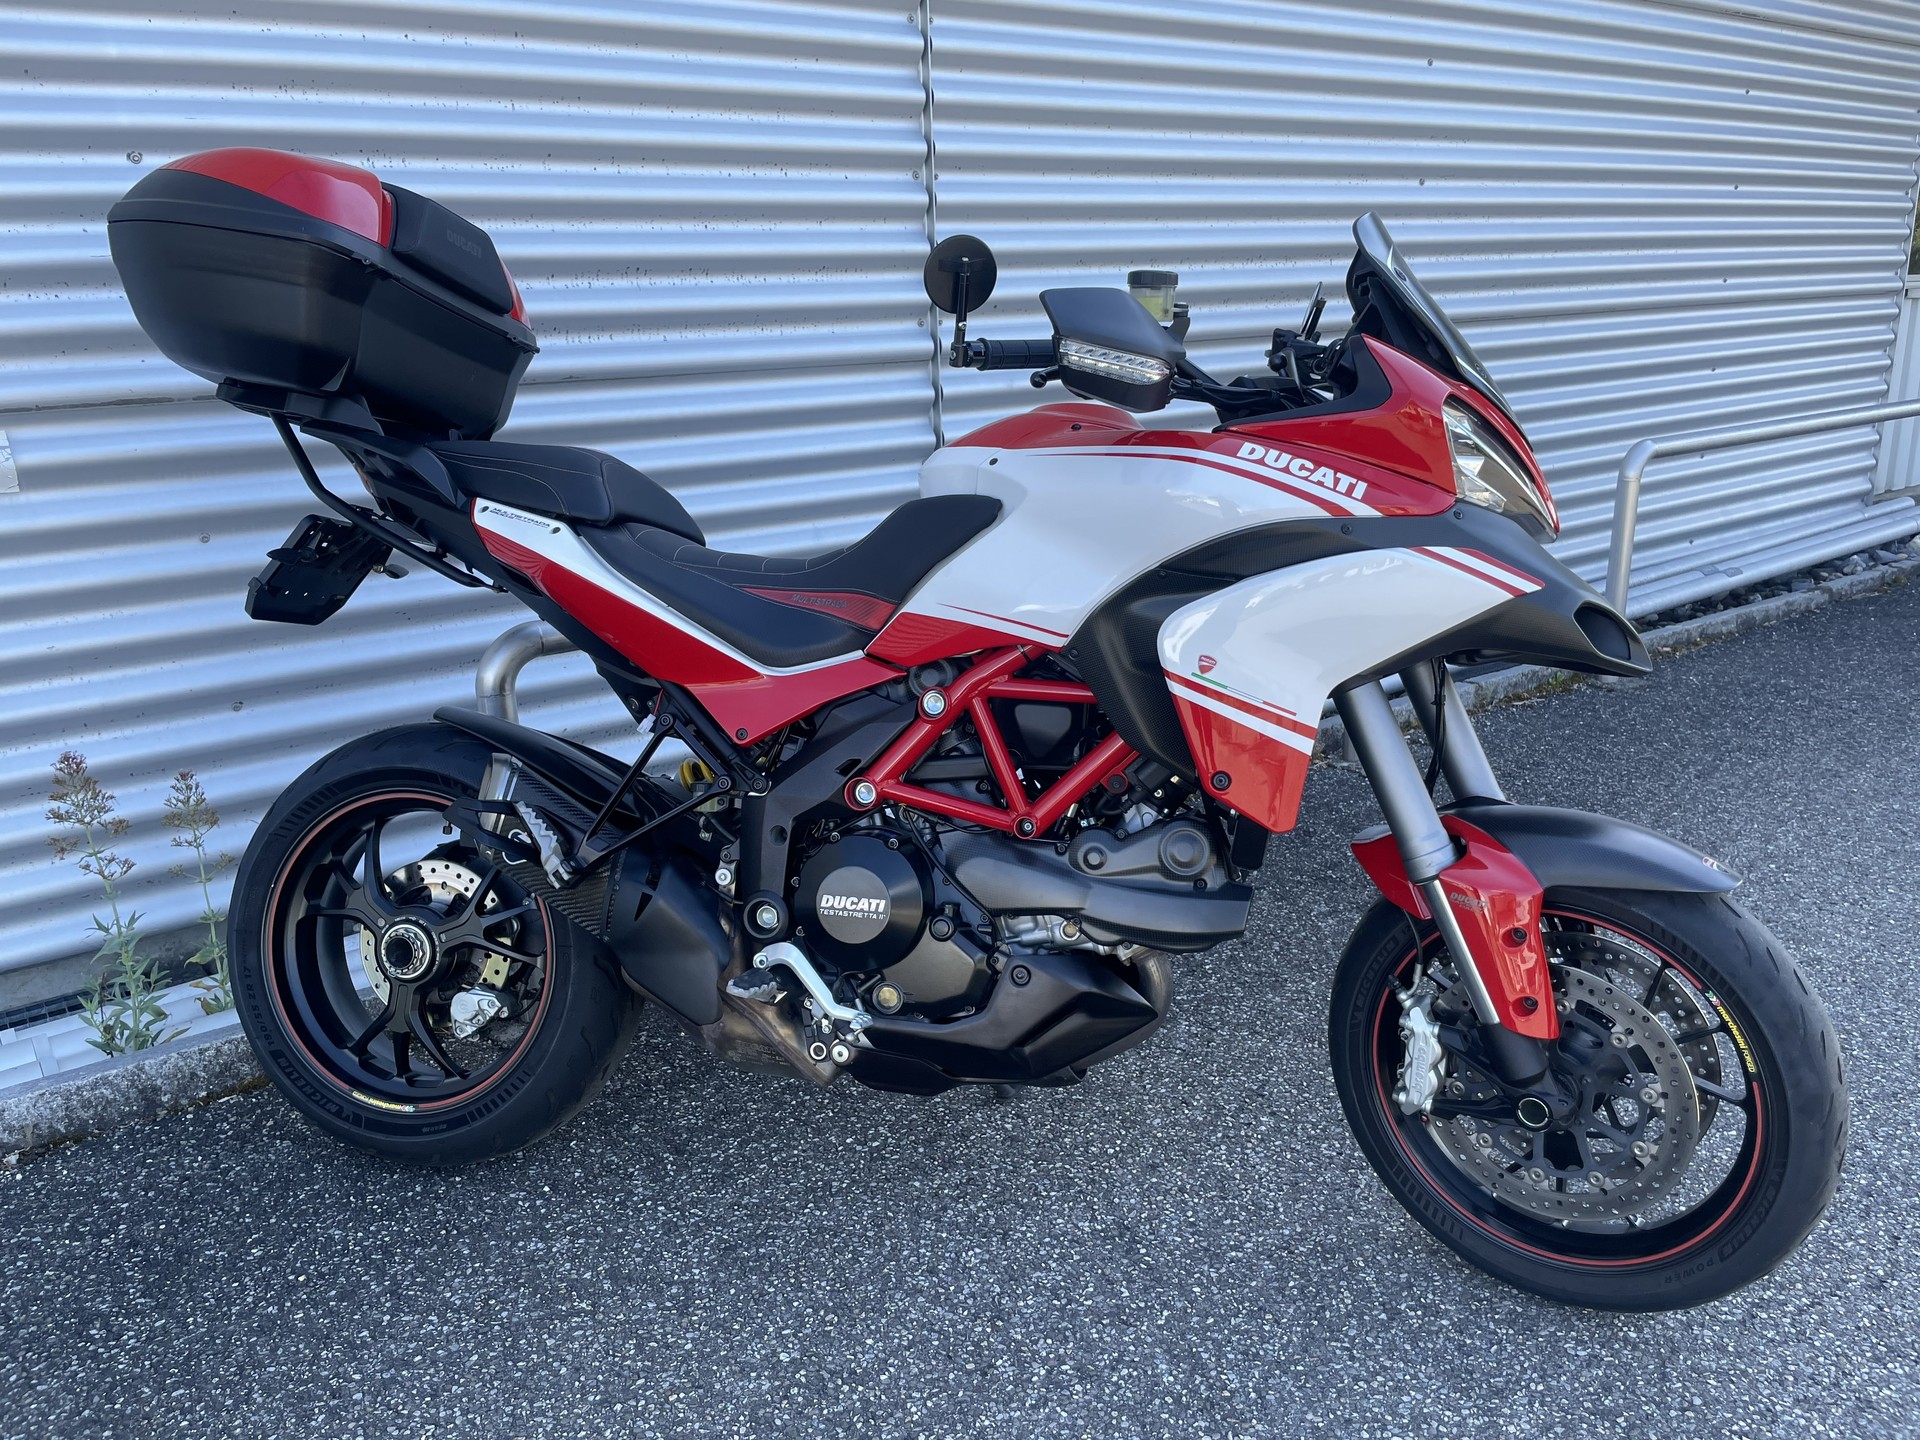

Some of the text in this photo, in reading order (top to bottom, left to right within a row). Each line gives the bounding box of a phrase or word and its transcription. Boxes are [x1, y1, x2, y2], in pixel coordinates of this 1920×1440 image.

[446, 229, 483, 259] DUCATI
[1236, 441, 1368, 500] DUCATI
[492, 507, 551, 527] MULTISTRADA
[792, 593, 849, 609] MULTISTRADA
[819, 908, 877, 919] TESTASTRETTA
[820, 894, 886, 913] DUCATI
[1354, 938, 1397, 1009] MICHELIN
[246, 983, 257, 1001] ZR
[251, 1004, 275, 1047] 190/55
[1716, 1005, 1749, 1050] marchesini
[1411, 1045, 1427, 1092] brembo
[276, 1054, 340, 1114] MICHELIN
[1663, 1256, 1715, 1284] POWER
